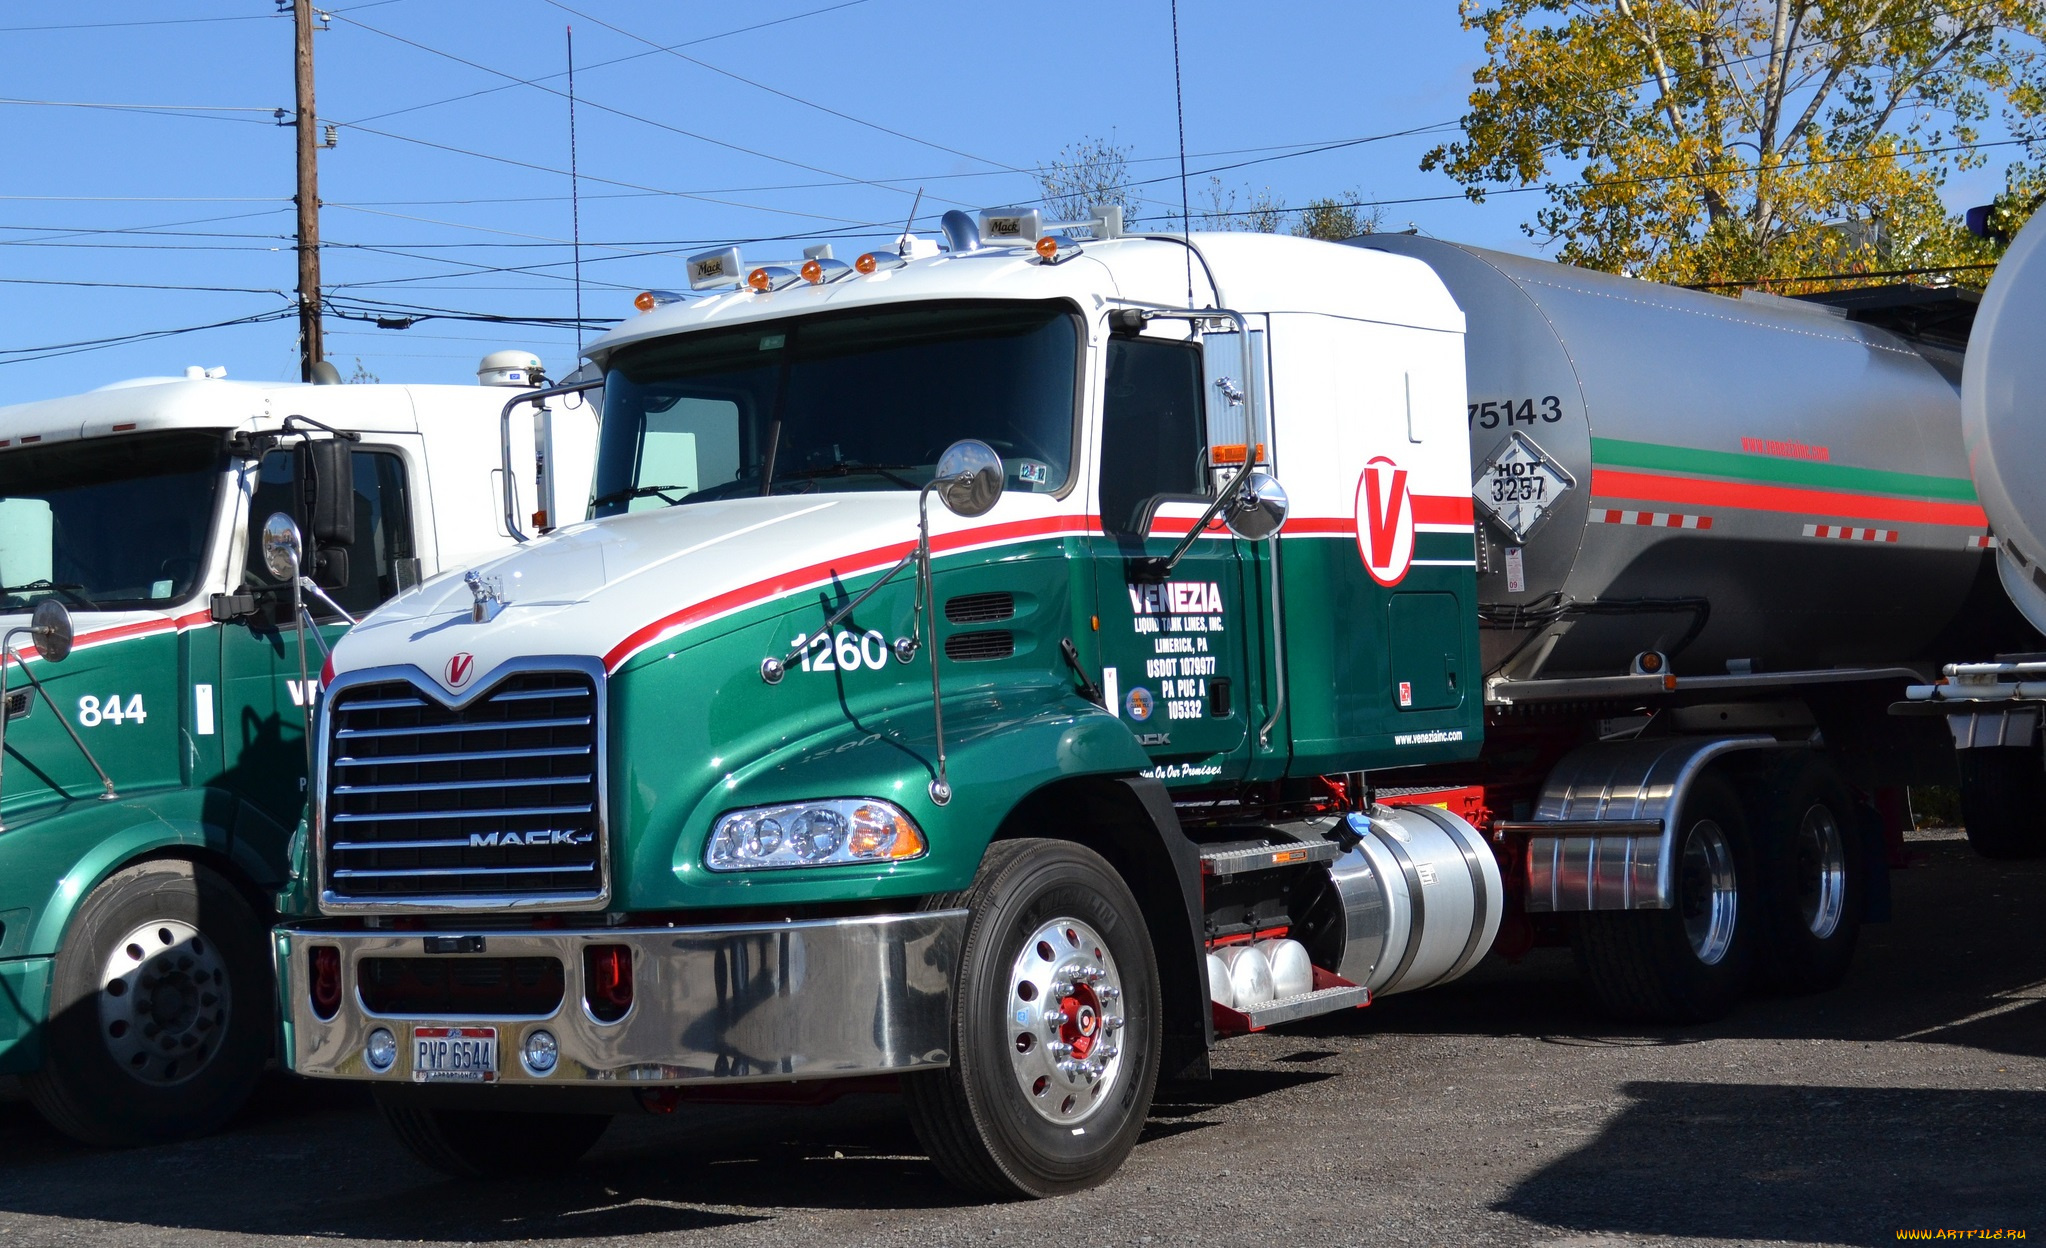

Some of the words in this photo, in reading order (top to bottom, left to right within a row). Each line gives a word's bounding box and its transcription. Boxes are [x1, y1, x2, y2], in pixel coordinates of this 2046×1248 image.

[991, 220, 1020, 236] Mack
[698, 262, 722, 277] Mack
[1499, 462, 1539, 477] HOT
[1492, 477, 1546, 502] 3257
[1364, 468, 1408, 568] V
[1128, 582, 1223, 614] VENEZIA
[1134, 617, 1160, 635] LIQUID
[1161, 616, 1183, 631] TANK
[1184, 616, 1208, 633] LINES,
[1208, 616, 1224, 632] INC.
[791, 630, 888, 672] 1260
[1154, 638, 1196, 655] LIMERICK,
[1196, 637, 1208, 652] PA
[450, 655, 474, 683] V
[1146, 658, 1178, 679] USDOT
[1179, 657, 1216, 676] 1079977
[1162, 680, 1175, 699] PA
[1177, 679, 1196, 698] PUC
[1199, 678, 1206, 697] A
[79, 694, 147, 727] 844
[1168, 700, 1202, 719] 105332
[1394, 730, 1463, 745] www.veneziainc.com
[1155, 765, 1166, 779] On
[1166, 764, 1181, 778] Our
[470, 829, 577, 847] MACK
[419, 1041, 448, 1069] PVP
[453, 1041, 490, 1069] 6544
